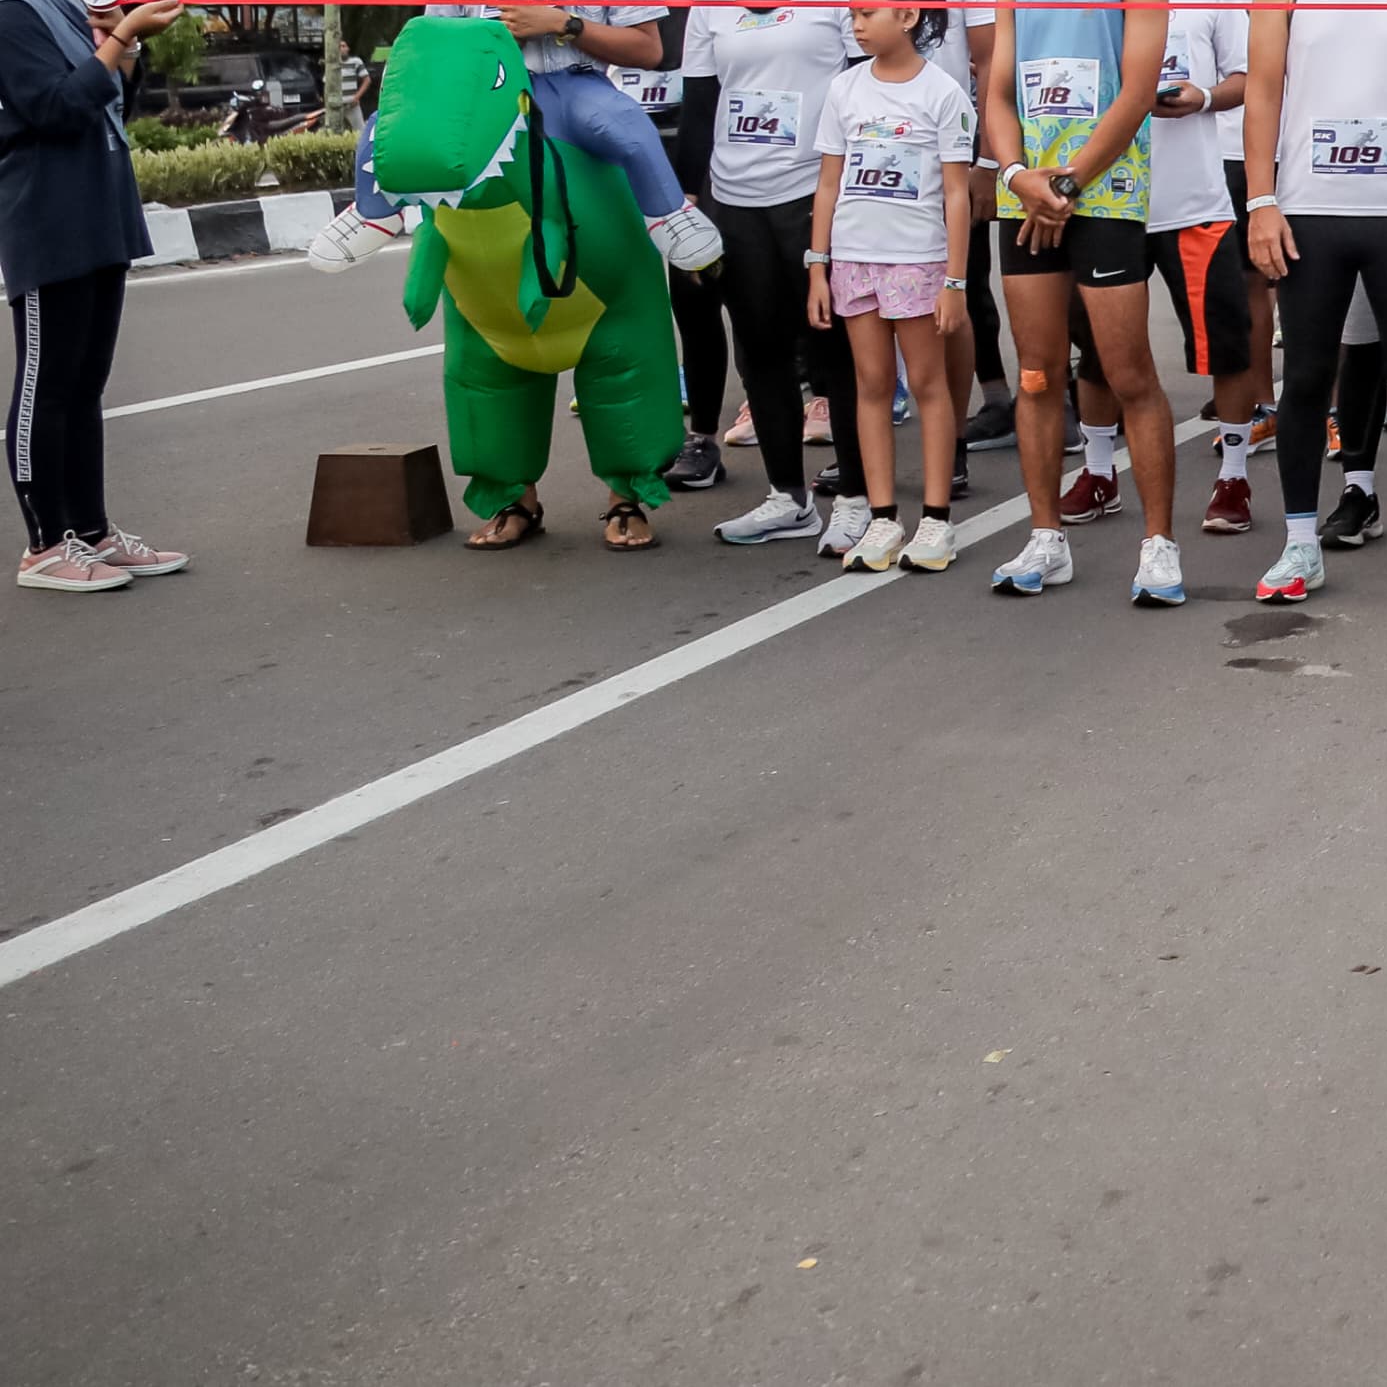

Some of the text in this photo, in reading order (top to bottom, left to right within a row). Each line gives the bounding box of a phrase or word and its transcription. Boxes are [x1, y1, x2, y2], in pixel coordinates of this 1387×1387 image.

[736, 115, 780, 135] 104
[1329, 146, 1382, 164] 109
[855, 168, 903, 188] 103
